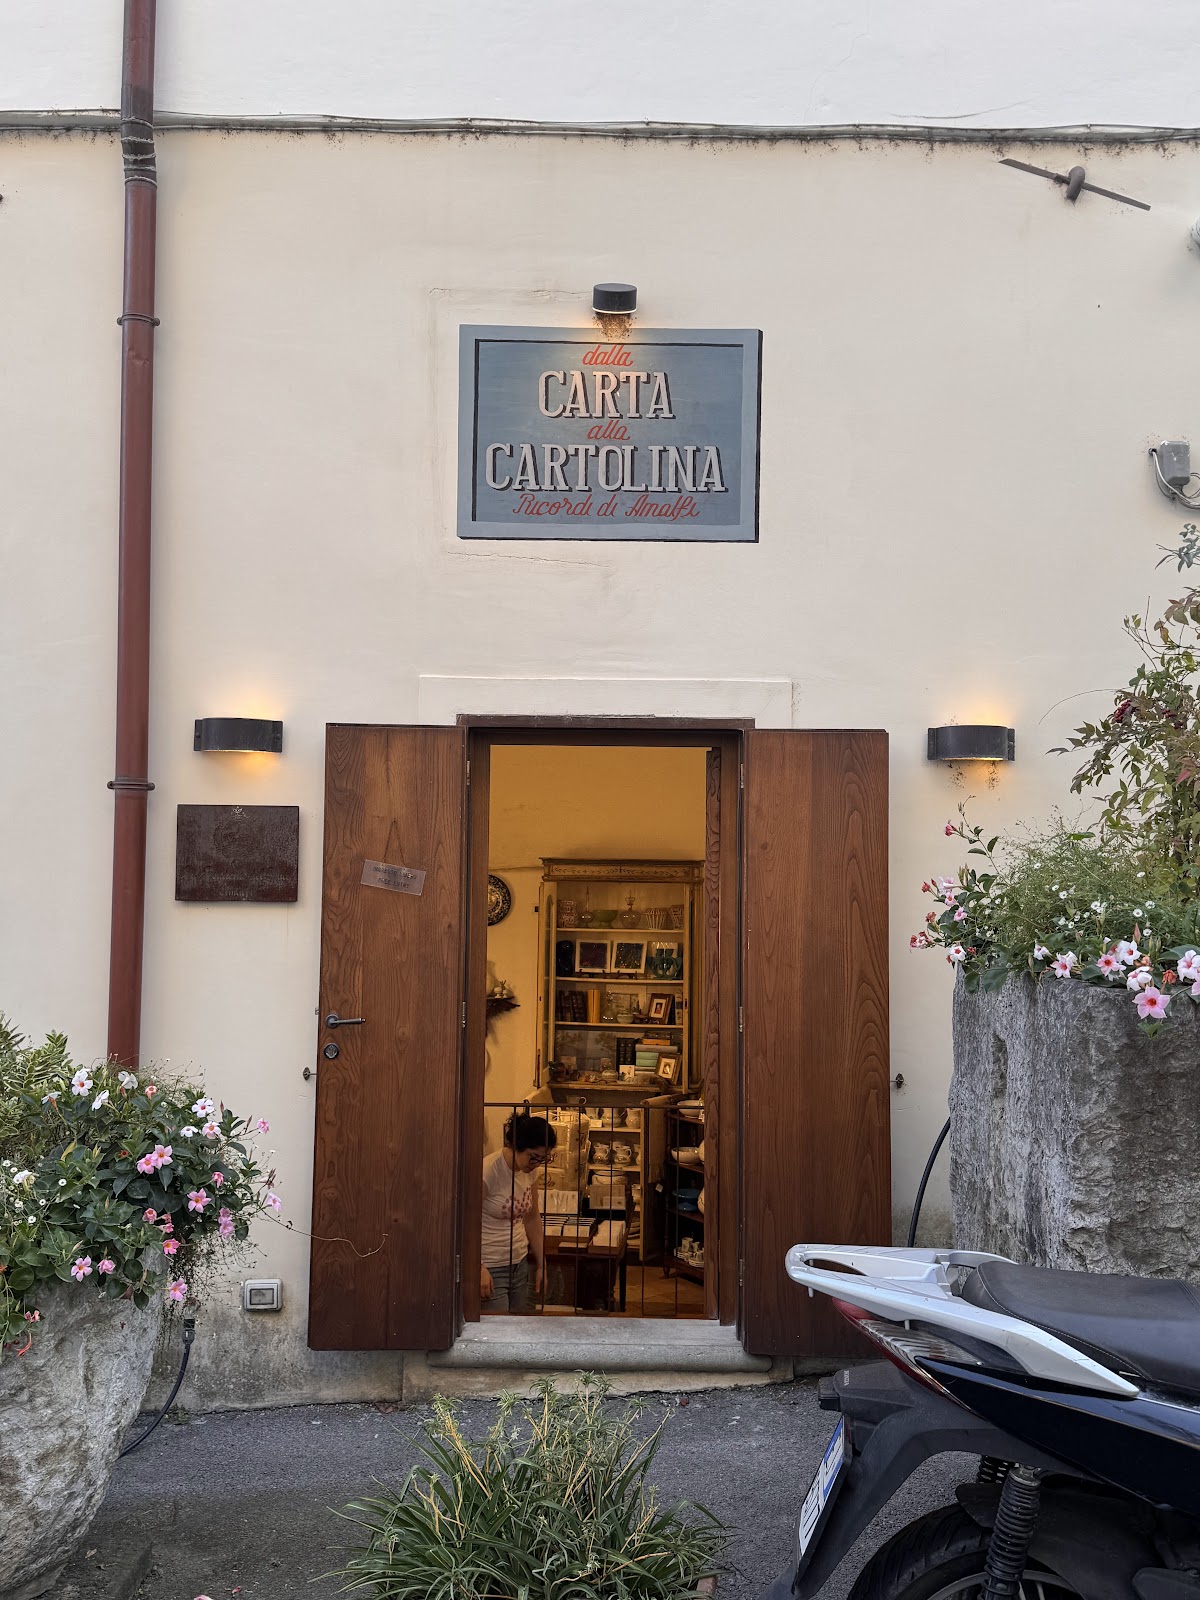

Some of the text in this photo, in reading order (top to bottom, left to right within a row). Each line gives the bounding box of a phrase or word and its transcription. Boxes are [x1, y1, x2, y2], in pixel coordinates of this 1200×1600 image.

[582, 344, 633, 367] dalla
[539, 370, 676, 419] CARTA
[587, 419, 631, 441] alla
[485, 442, 729, 493] CARTOLINA
[512, 493, 700, 521] Ricordi di Amalfi
